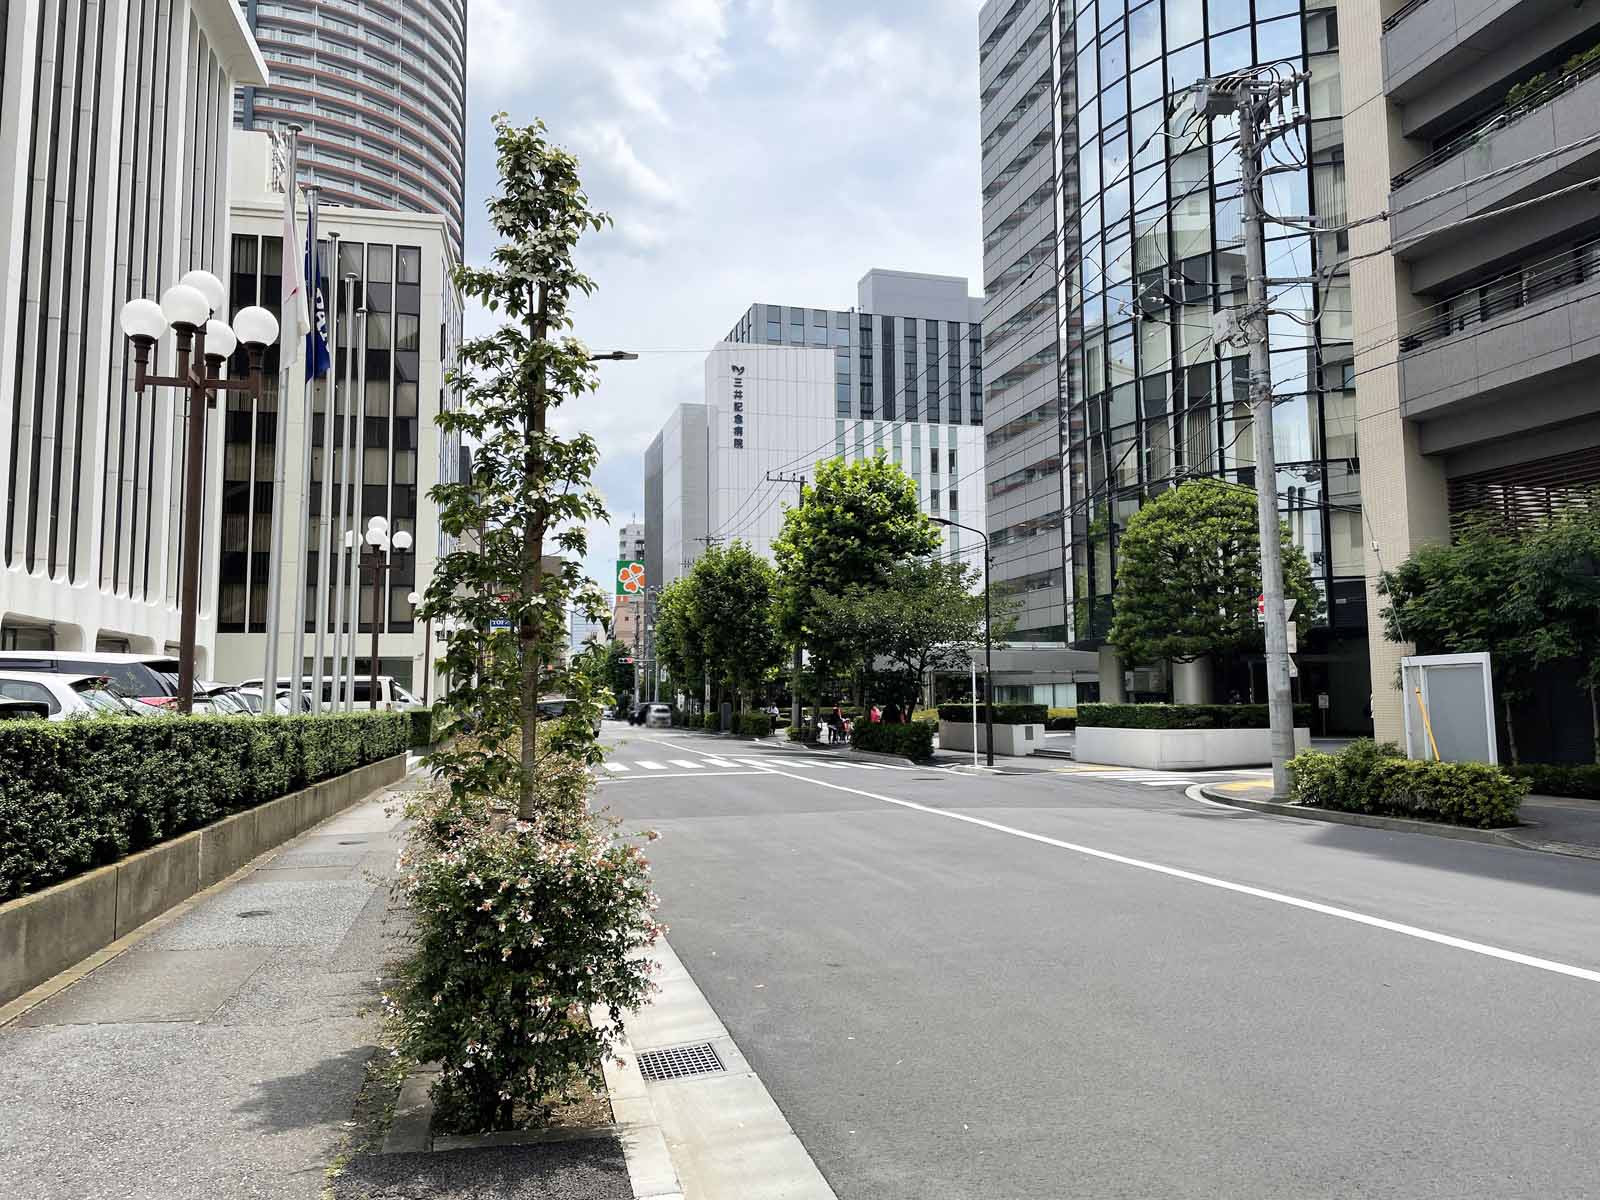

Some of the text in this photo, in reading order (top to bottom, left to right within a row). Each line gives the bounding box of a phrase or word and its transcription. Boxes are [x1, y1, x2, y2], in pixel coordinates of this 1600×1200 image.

[733, 377, 744, 449] 三井記念病院
